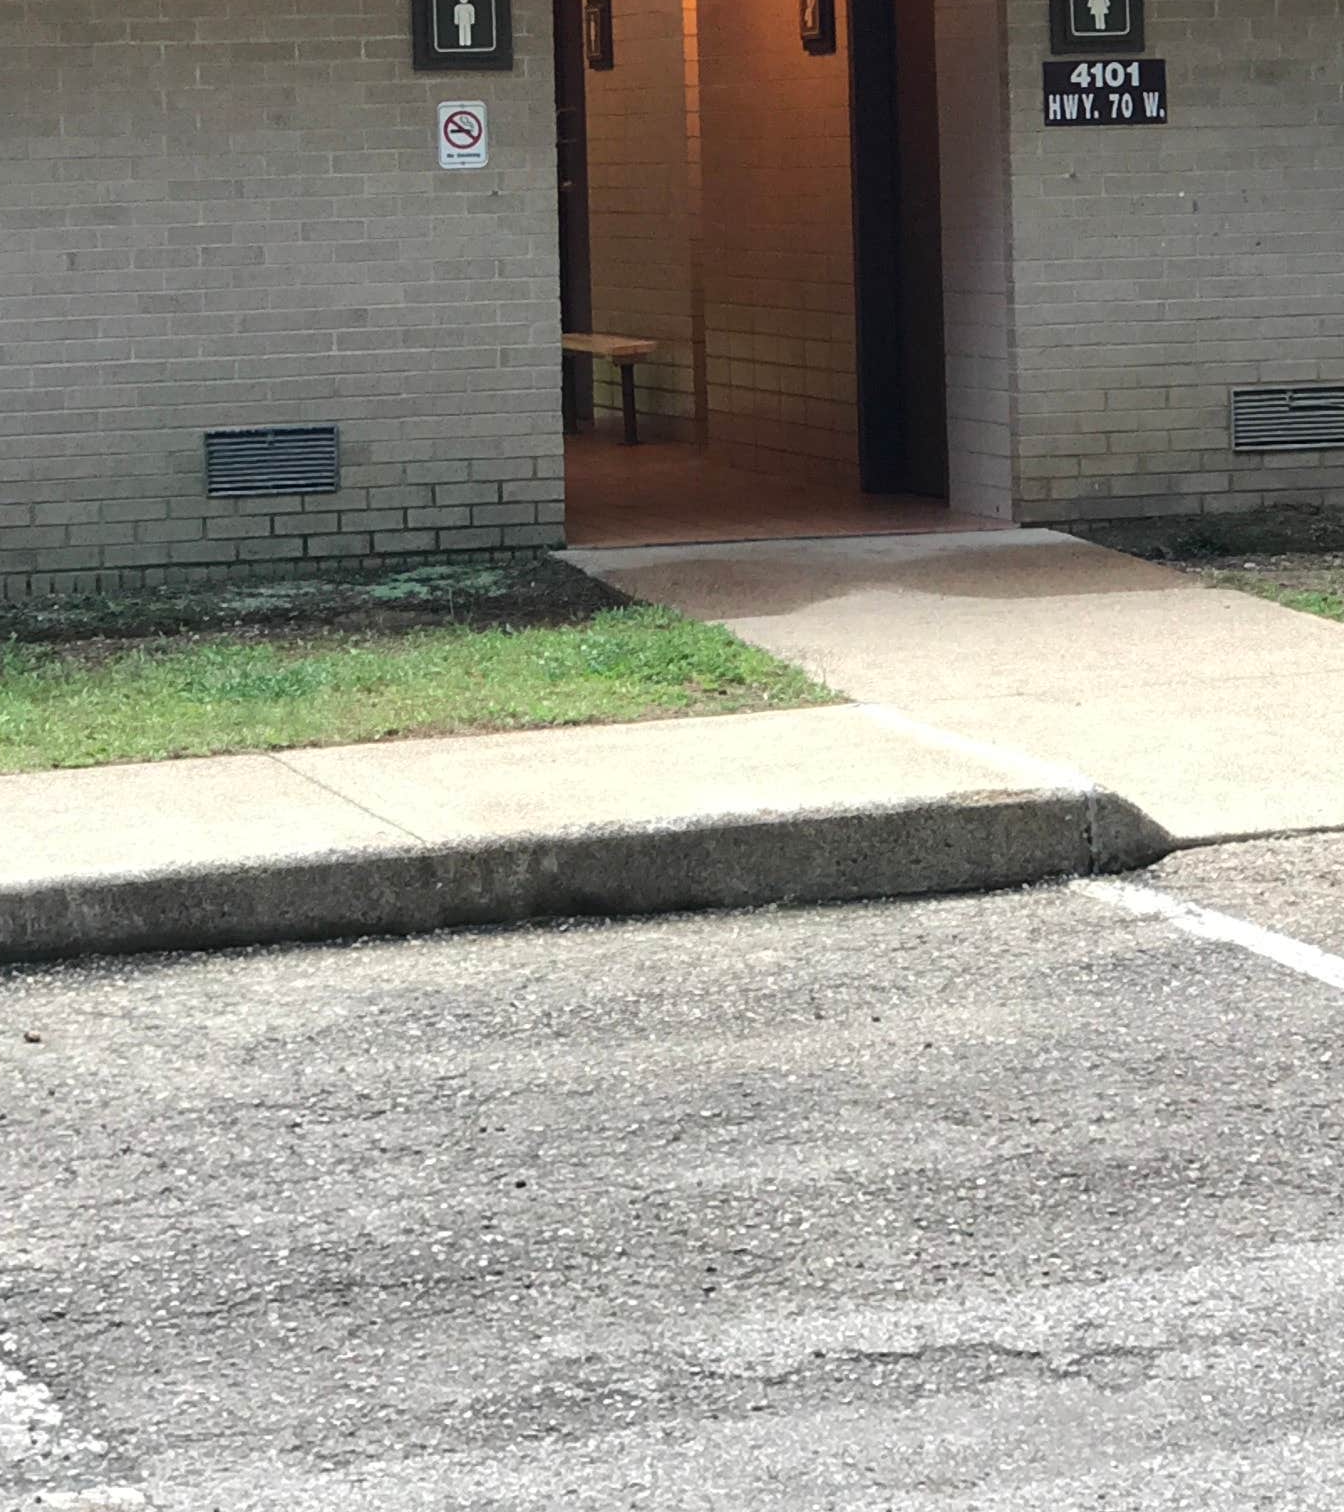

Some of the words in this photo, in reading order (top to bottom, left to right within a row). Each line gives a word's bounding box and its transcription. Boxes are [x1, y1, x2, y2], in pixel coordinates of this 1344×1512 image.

[1070, 61, 1140, 88] 4101
[1048, 93, 1099, 120] HWY.
[1109, 92, 1133, 119] 70
[1142, 91, 1165, 118] W.
